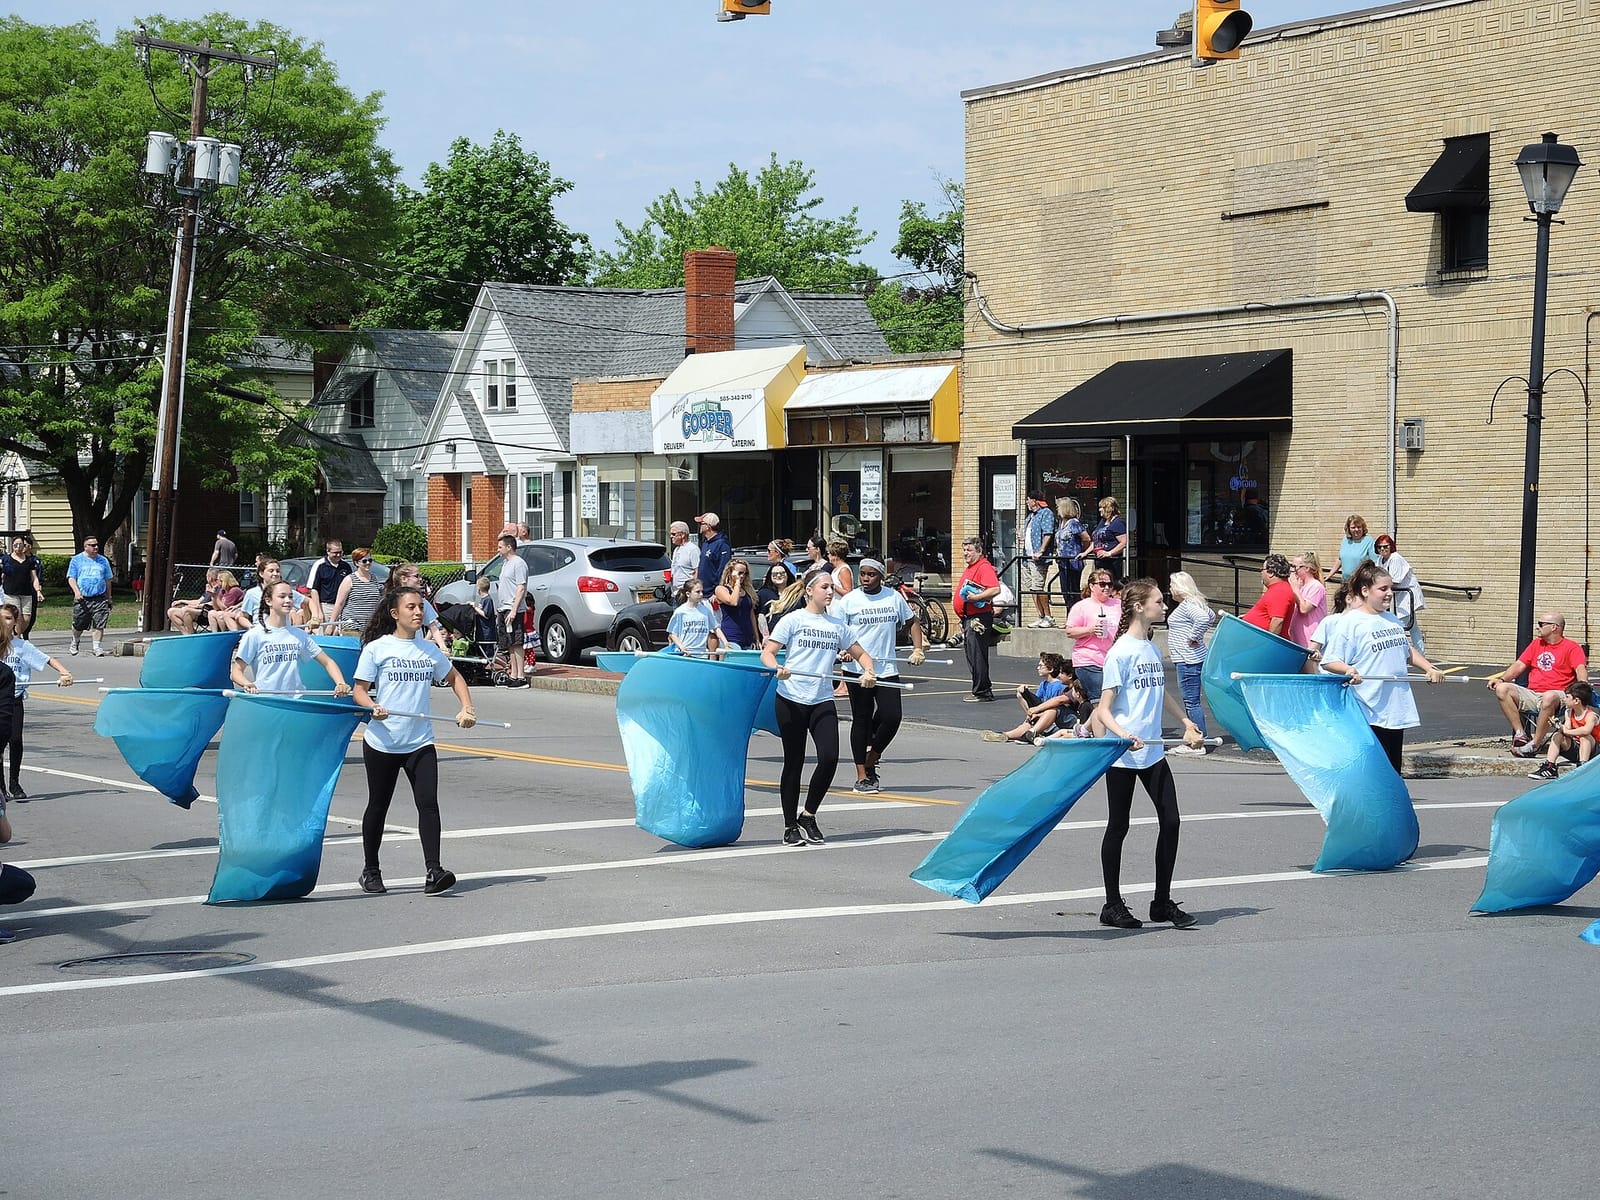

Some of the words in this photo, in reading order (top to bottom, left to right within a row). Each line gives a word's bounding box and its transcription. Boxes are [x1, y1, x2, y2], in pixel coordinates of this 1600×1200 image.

[682, 409, 735, 439] COOPER
[664, 442, 685, 450] DELIVERY
[731, 439, 756, 448] CATERING
